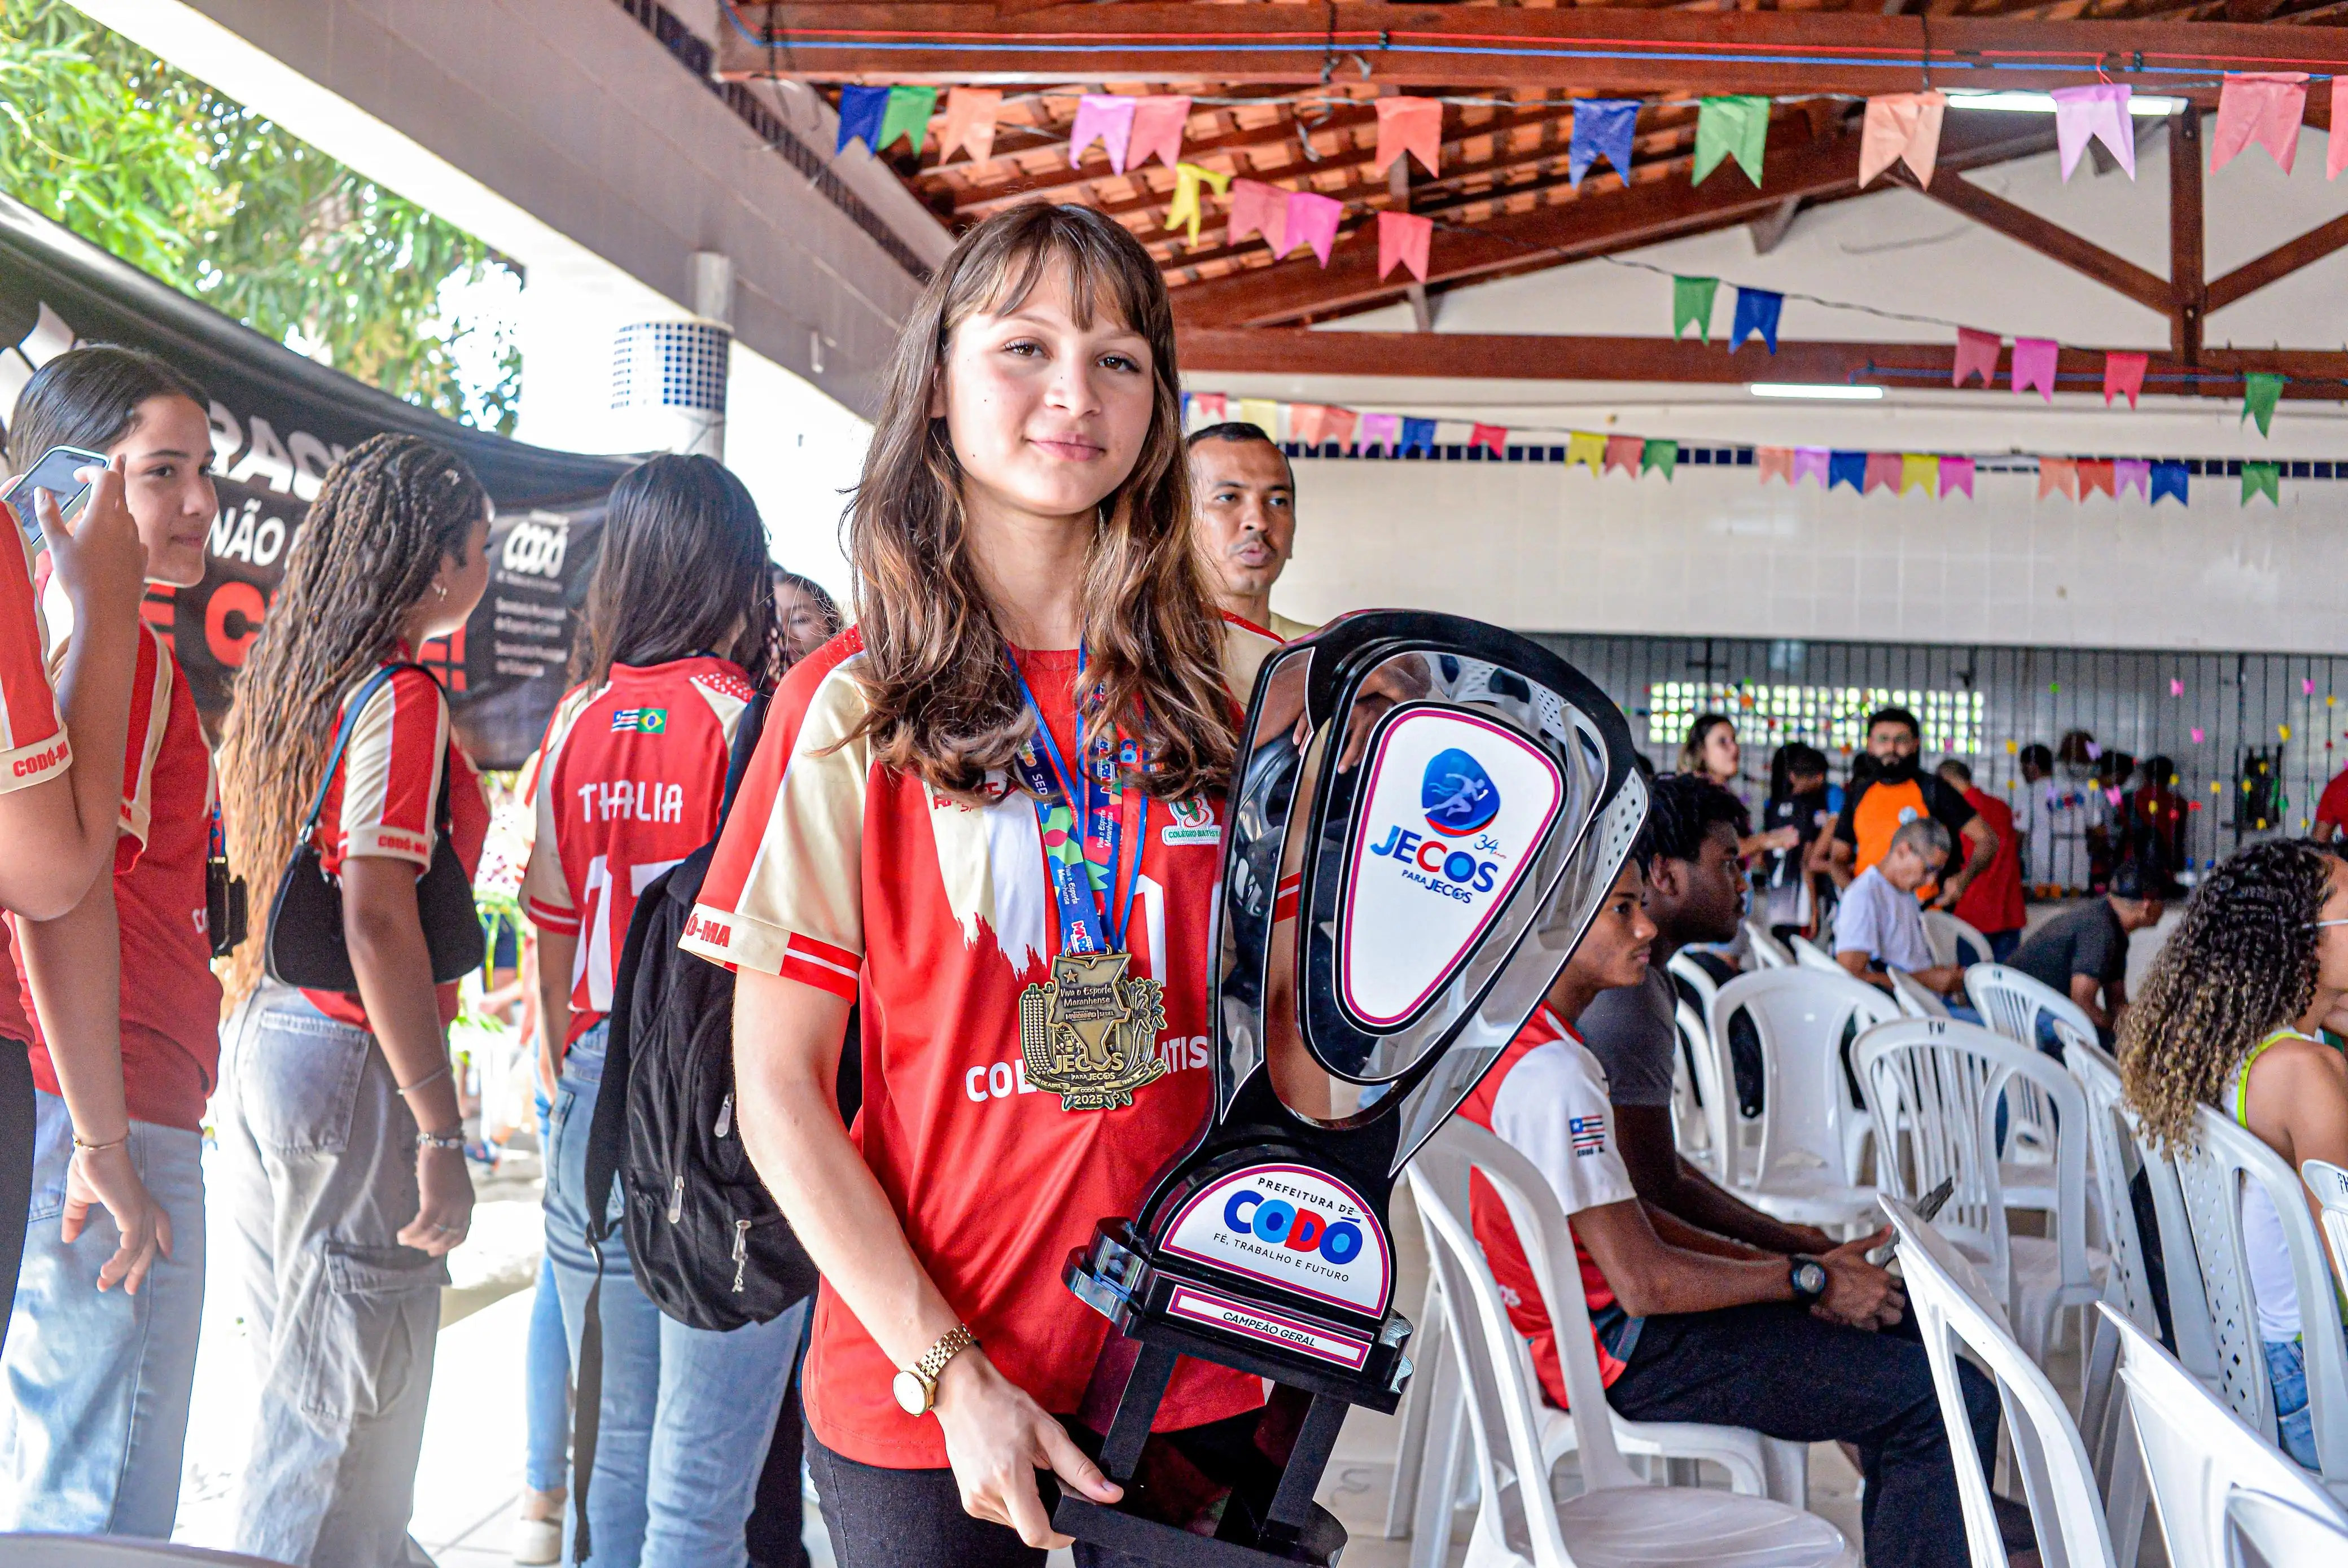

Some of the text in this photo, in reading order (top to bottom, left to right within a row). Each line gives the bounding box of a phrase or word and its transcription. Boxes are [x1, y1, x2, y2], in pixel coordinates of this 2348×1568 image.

[211, 498, 286, 566] NÃO
[577, 779, 684, 824] THALIA
[1032, 774, 1052, 811] SEDL
[1370, 825, 1499, 893] JECOS
[1068, 882, 1080, 905] Esporte
[684, 913, 731, 948] Ó-MA
[1061, 988, 1075, 997] Viva
[1084, 984, 1112, 997] Esporte
[1064, 997, 1110, 1008] Maranhense
[965, 1035, 1208, 1102] COL ATIS
[1075, 1094, 1103, 1105] 2025
[1258, 1177, 1334, 1209] PREFEITURA
[1223, 1189, 1363, 1265] CODÓ
[1213, 1233, 1350, 1282] FÉ, TRABALHO E FUTURO
[1223, 1312, 1316, 1347] CAMPEÃO GERAL
